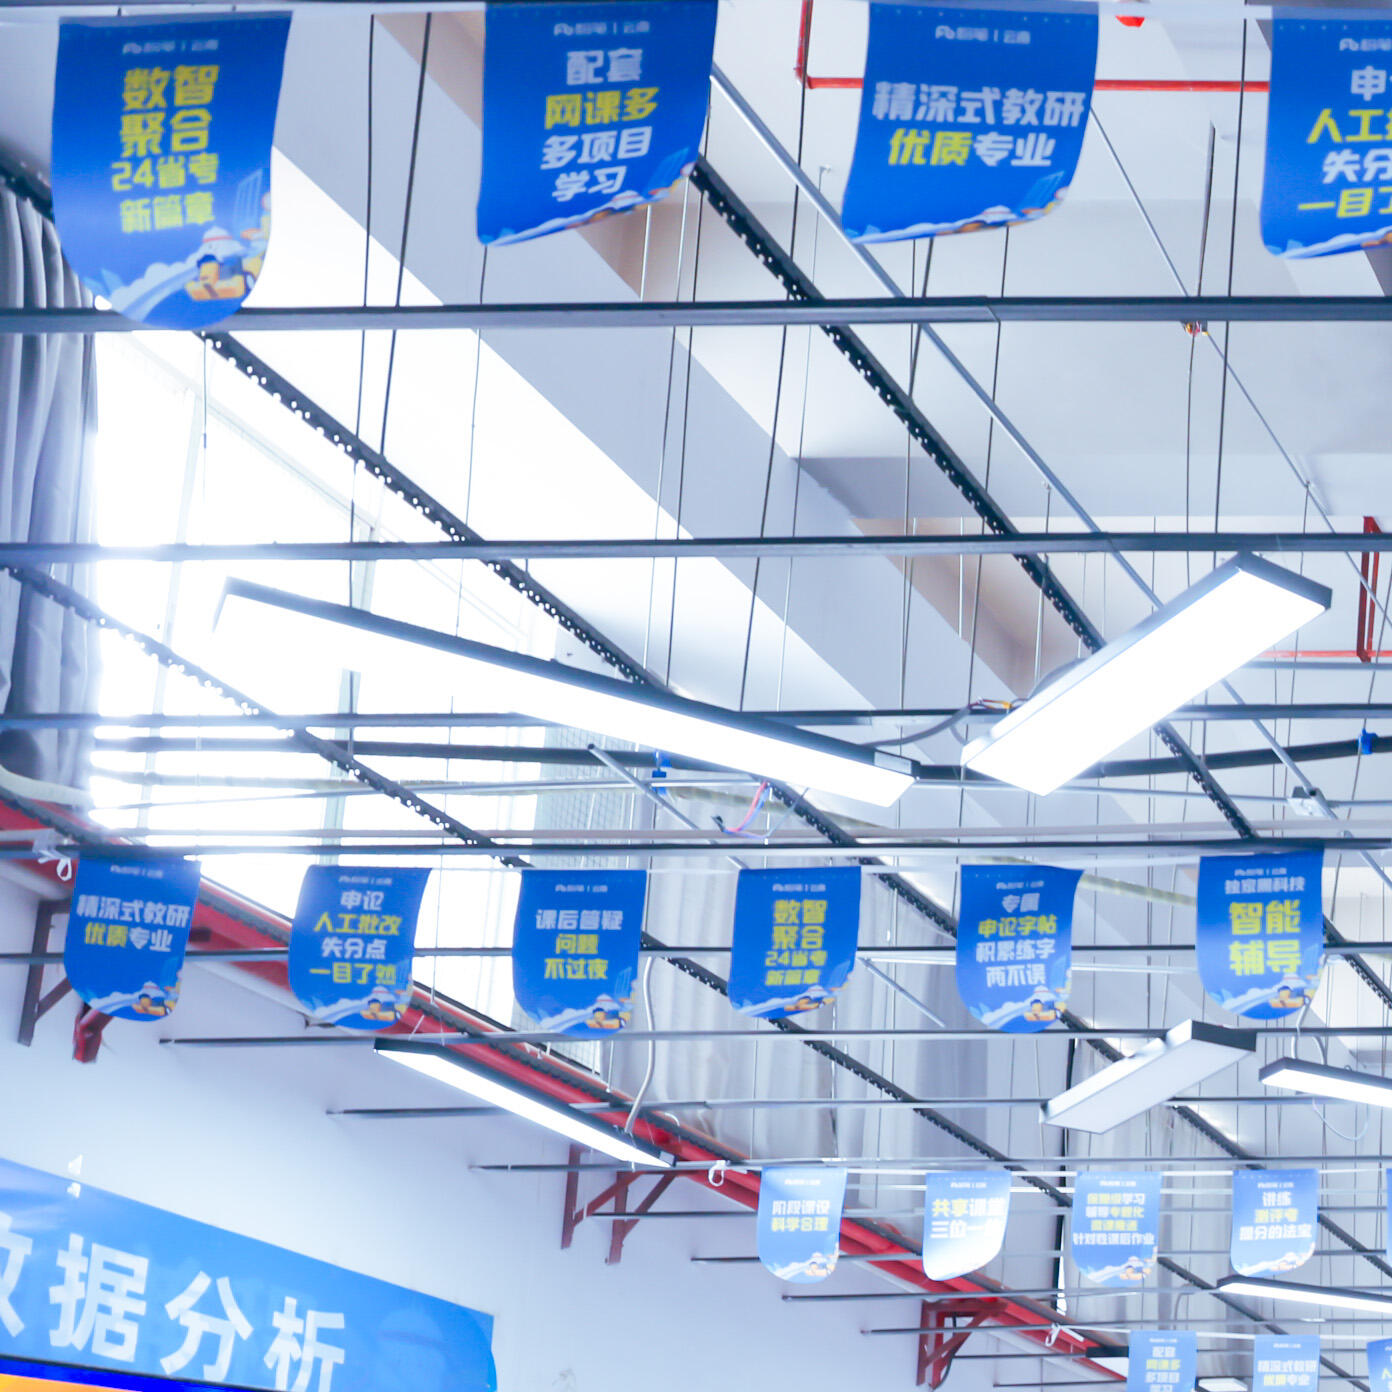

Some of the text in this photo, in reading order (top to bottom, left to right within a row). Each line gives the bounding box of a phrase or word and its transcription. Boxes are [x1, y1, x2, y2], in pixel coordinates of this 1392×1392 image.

[567, 48, 643, 85] 配套
[123, 65, 219, 111] 数智
[872, 82, 1087, 127] 精深式教研
[545, 87, 660, 129] 网课多
[120, 109, 213, 157] 聚合
[541, 126, 653, 170] 多项目
[888, 129, 1057, 167] 优质专业
[112, 153, 219, 192] 24省考
[552, 165, 627, 201] 学习
[120, 192, 216, 233] 新篇章
[77, 895, 192, 929] 精深式教研
[340, 890, 384, 911] 申论
[774, 899, 828, 924] 数智
[1229, 899, 1302, 935] 智能
[85, 924, 174, 952] 优质专业
[314, 912, 402, 936] 人工批改
[772, 925, 826, 950] 聚合
[978, 915, 1058, 937] 申论字帖
[321, 938, 387, 960] 失分点
[556, 934, 599, 954] 问题
[1229, 939, 1302, 976] 辅导
[310, 962, 398, 985] 一目了然
[544, 958, 609, 980] 不过夜
